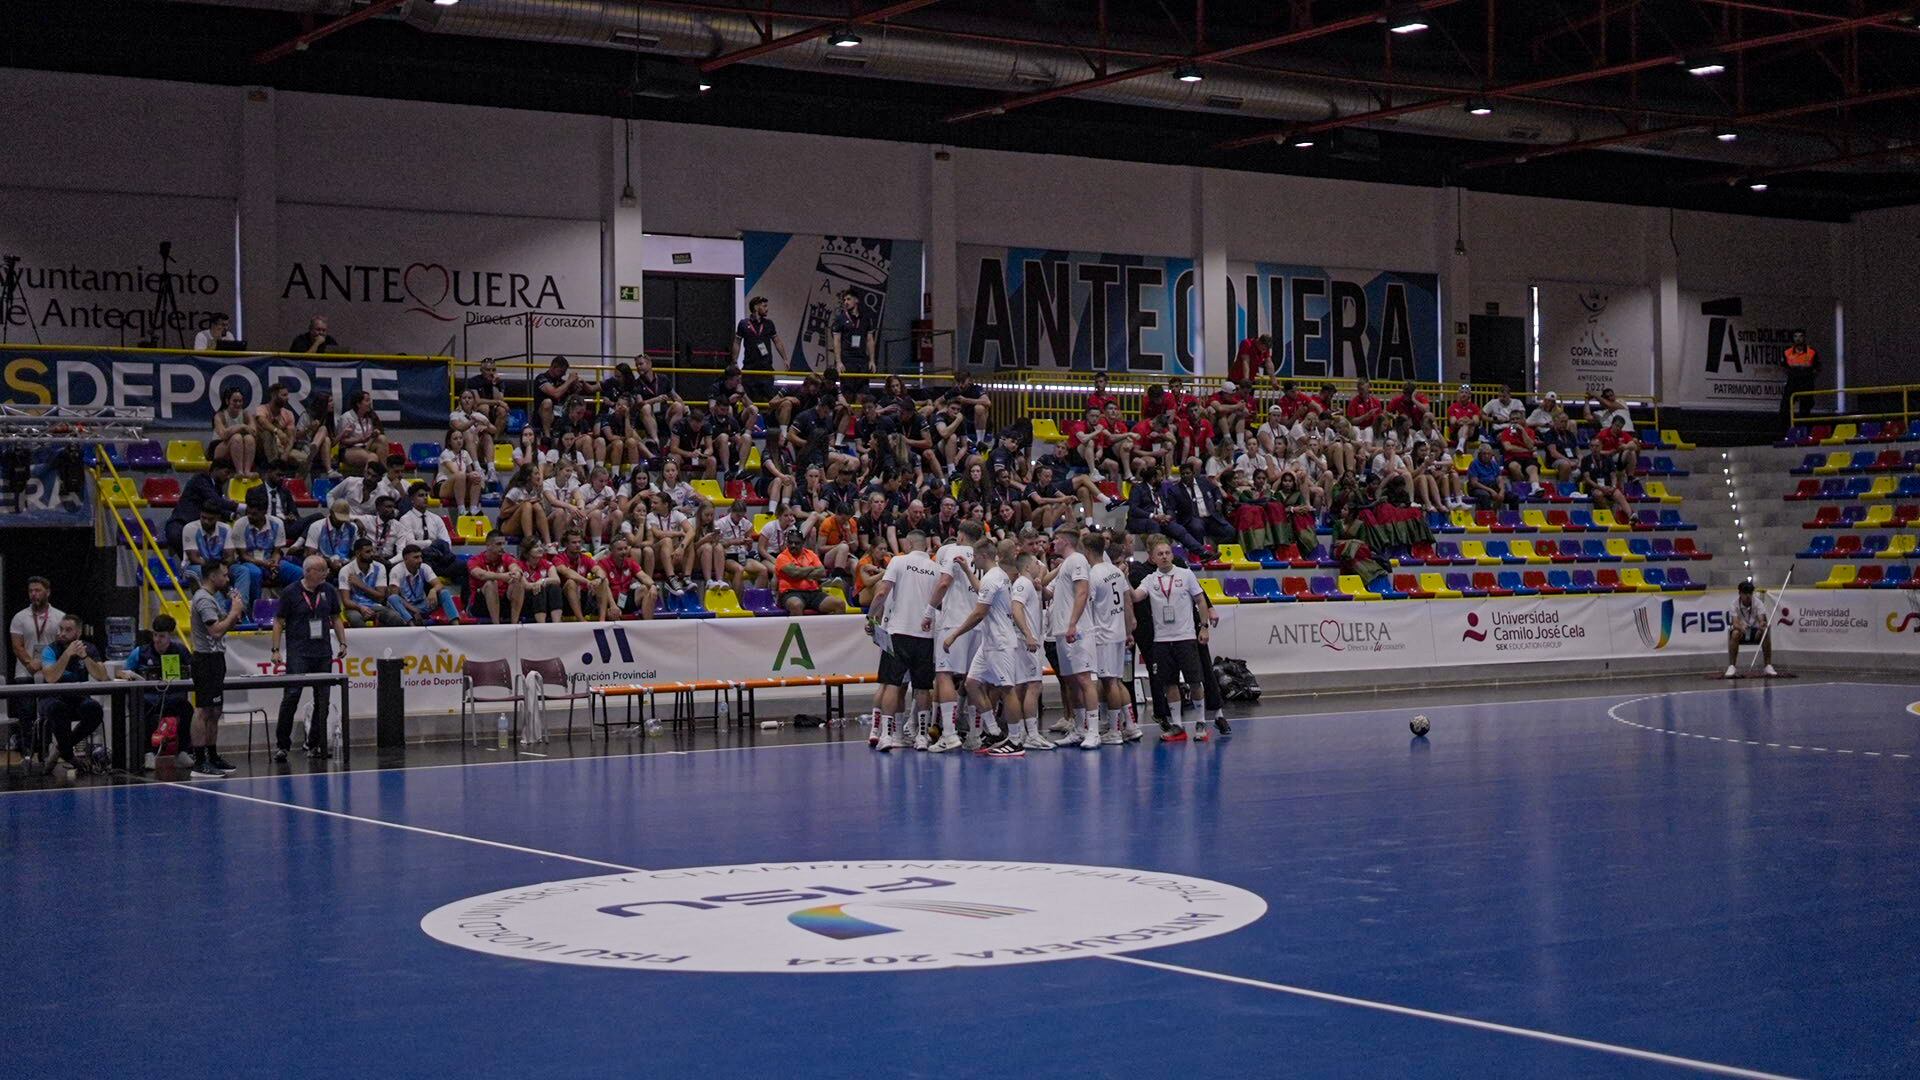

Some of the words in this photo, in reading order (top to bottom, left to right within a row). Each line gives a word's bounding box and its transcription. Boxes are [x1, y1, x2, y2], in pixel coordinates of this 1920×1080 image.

[0, 264, 219, 295] untamiento
[282, 262, 565, 321] ANTEQUERA
[41, 299, 214, 338] Antequera
[465, 311, 511, 326] Directa
[544, 315, 595, 328] corazón
[1570, 346, 1593, 356] COPA
[1603, 348, 1618, 358] REY
[1572, 358, 1580, 366] DE
[1714, 384, 1762, 395] PATRIMONIO
[906, 565, 935, 576] POLSKA
[1111, 582, 1120, 605] 5
[1491, 610, 1559, 625] Universidad
[1799, 607, 1850, 617] Universidad
[1799, 617, 1828, 627] Camilo
[1829, 617, 1849, 627] José
[1850, 618, 1868, 628] Cela
[1268, 620, 1391, 651] ANTEQUERA
[1494, 626, 1534, 641] Camilo
[1535, 624, 1561, 640] José
[1562, 624, 1585, 638] Cela
[566, 672, 610, 682] iputción
[612, 669, 656, 680] Provincial
[346, 680, 378, 690] Consej
[420, 678, 431, 686] de
[433, 676, 464, 687] Deport
[560, 948, 693, 965] FISU
[785, 952, 939, 966] 2024
